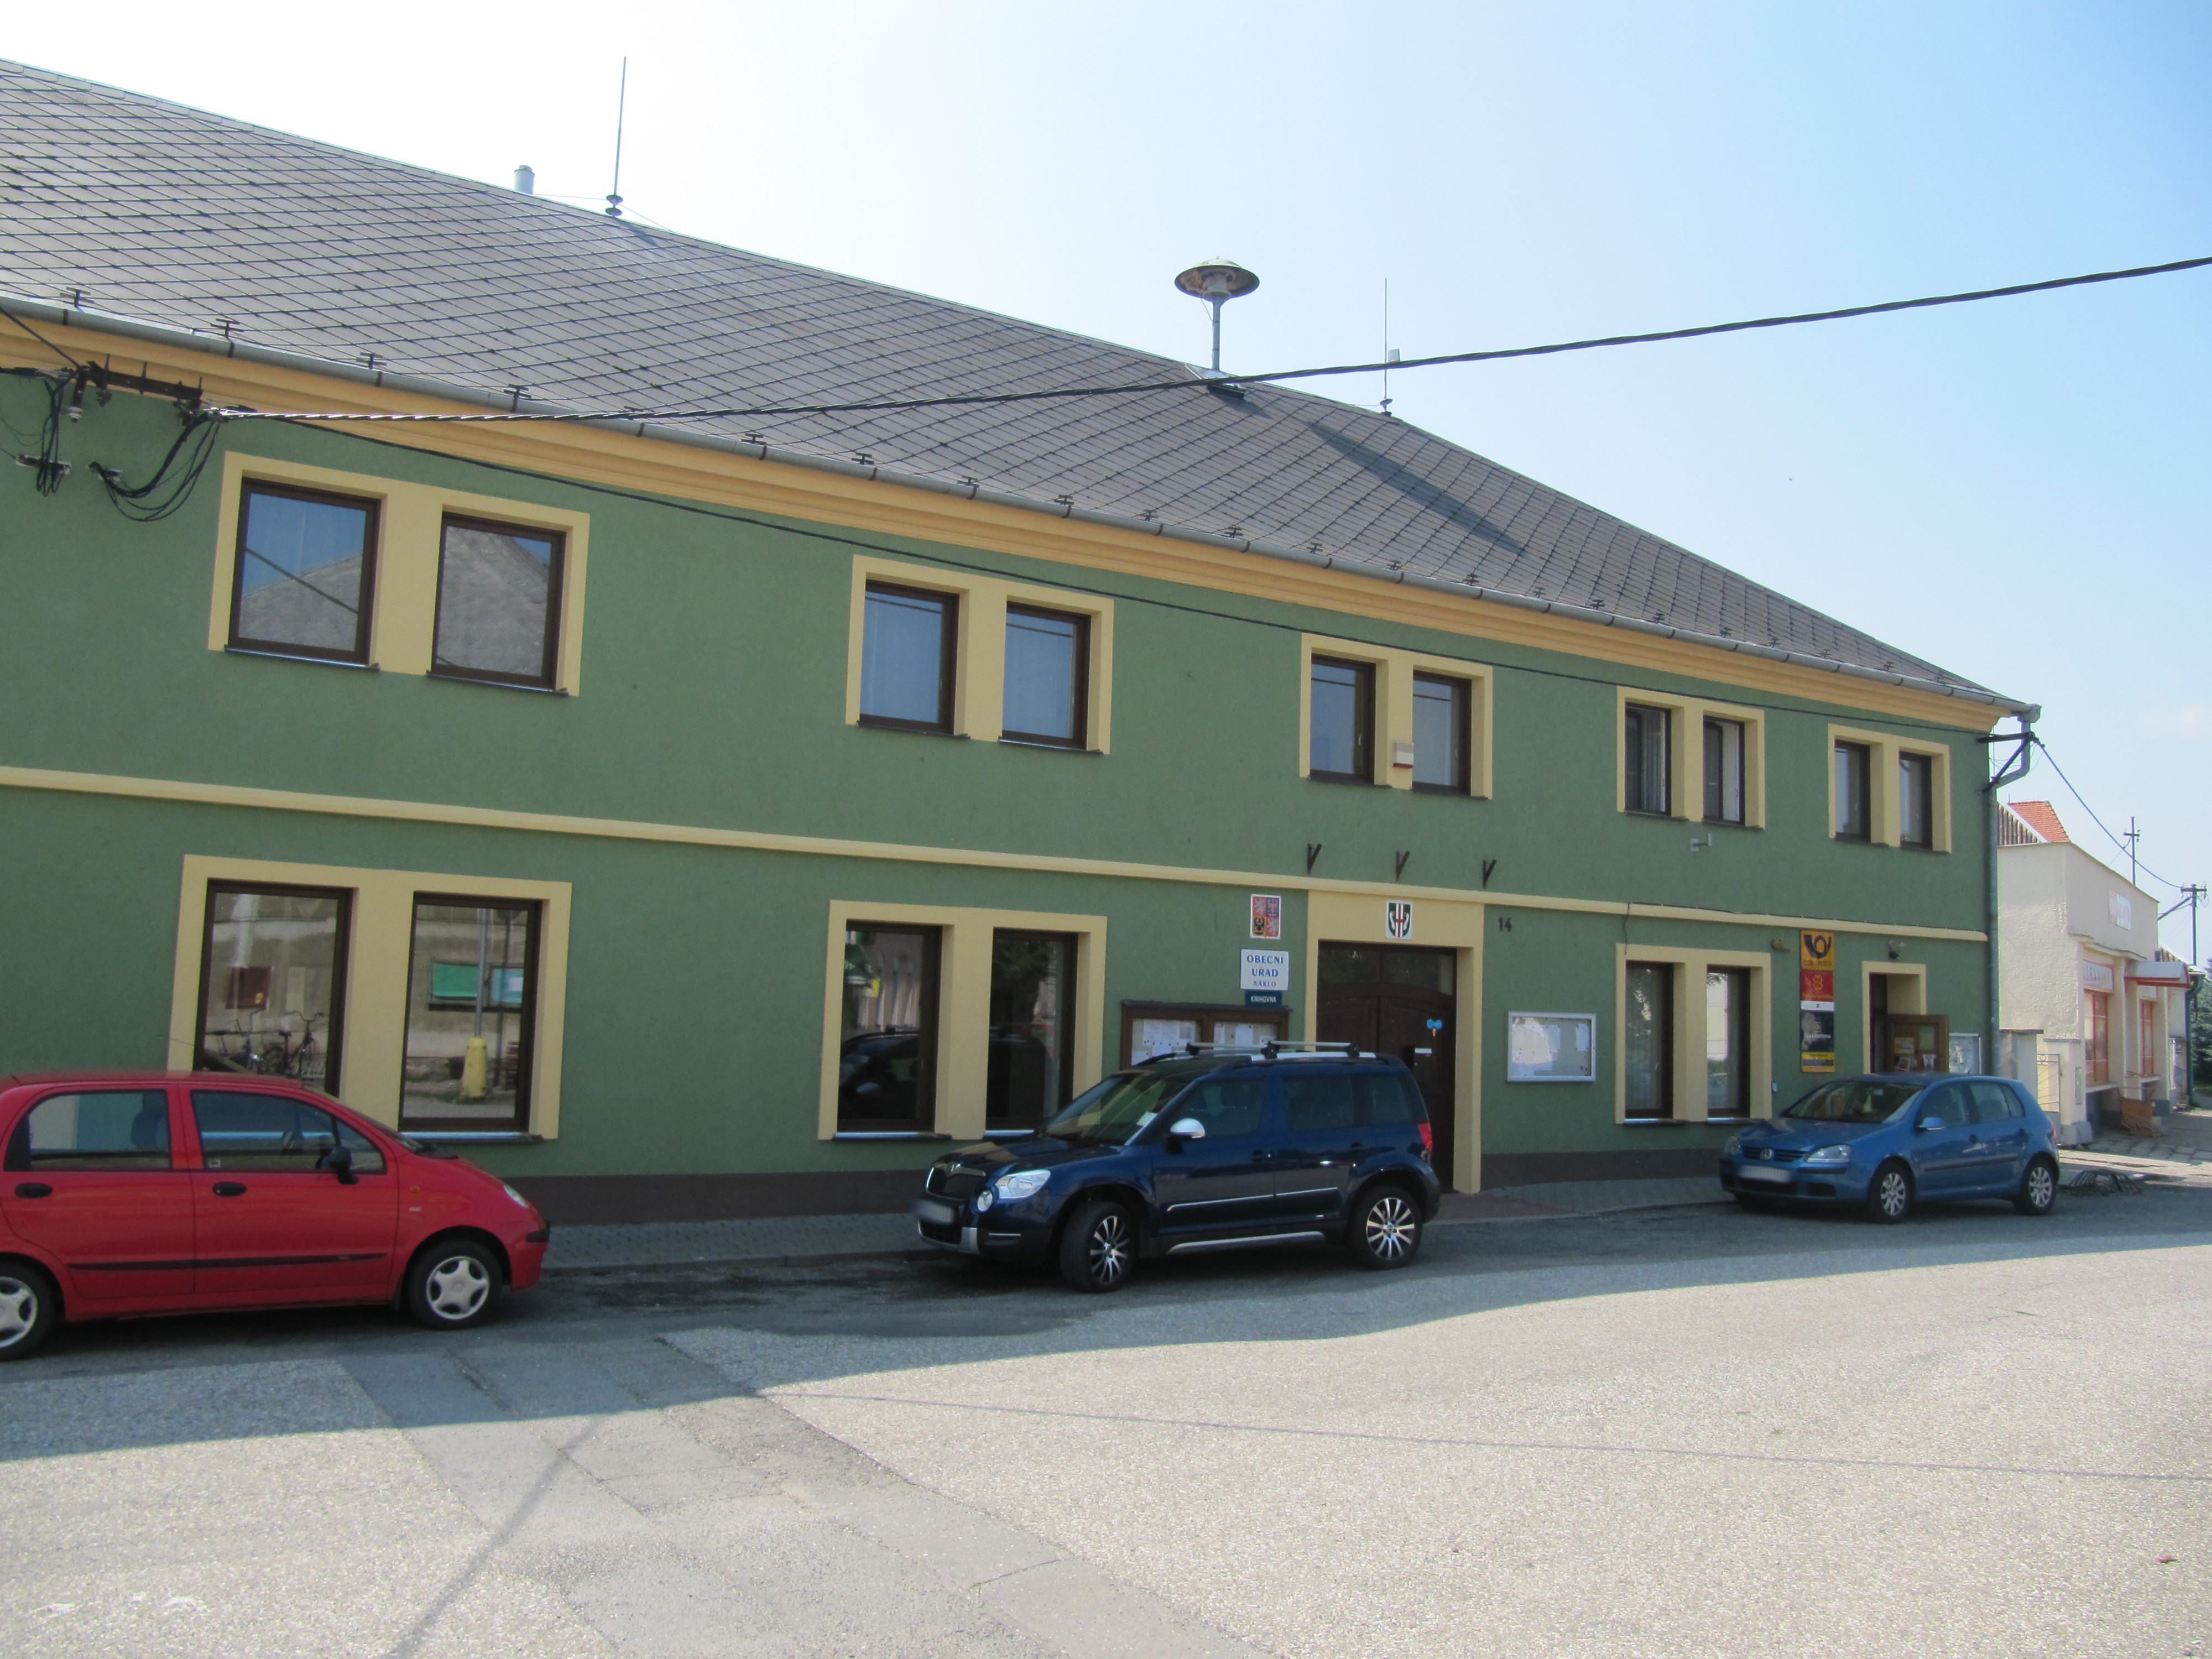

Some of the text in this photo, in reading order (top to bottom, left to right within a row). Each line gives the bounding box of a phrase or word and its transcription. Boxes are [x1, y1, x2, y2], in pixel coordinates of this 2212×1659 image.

[1499, 917, 1512, 932] 14
[1246, 954, 1284, 964] OBECNÍ
[1251, 966, 1279, 977] ÚŘAD
